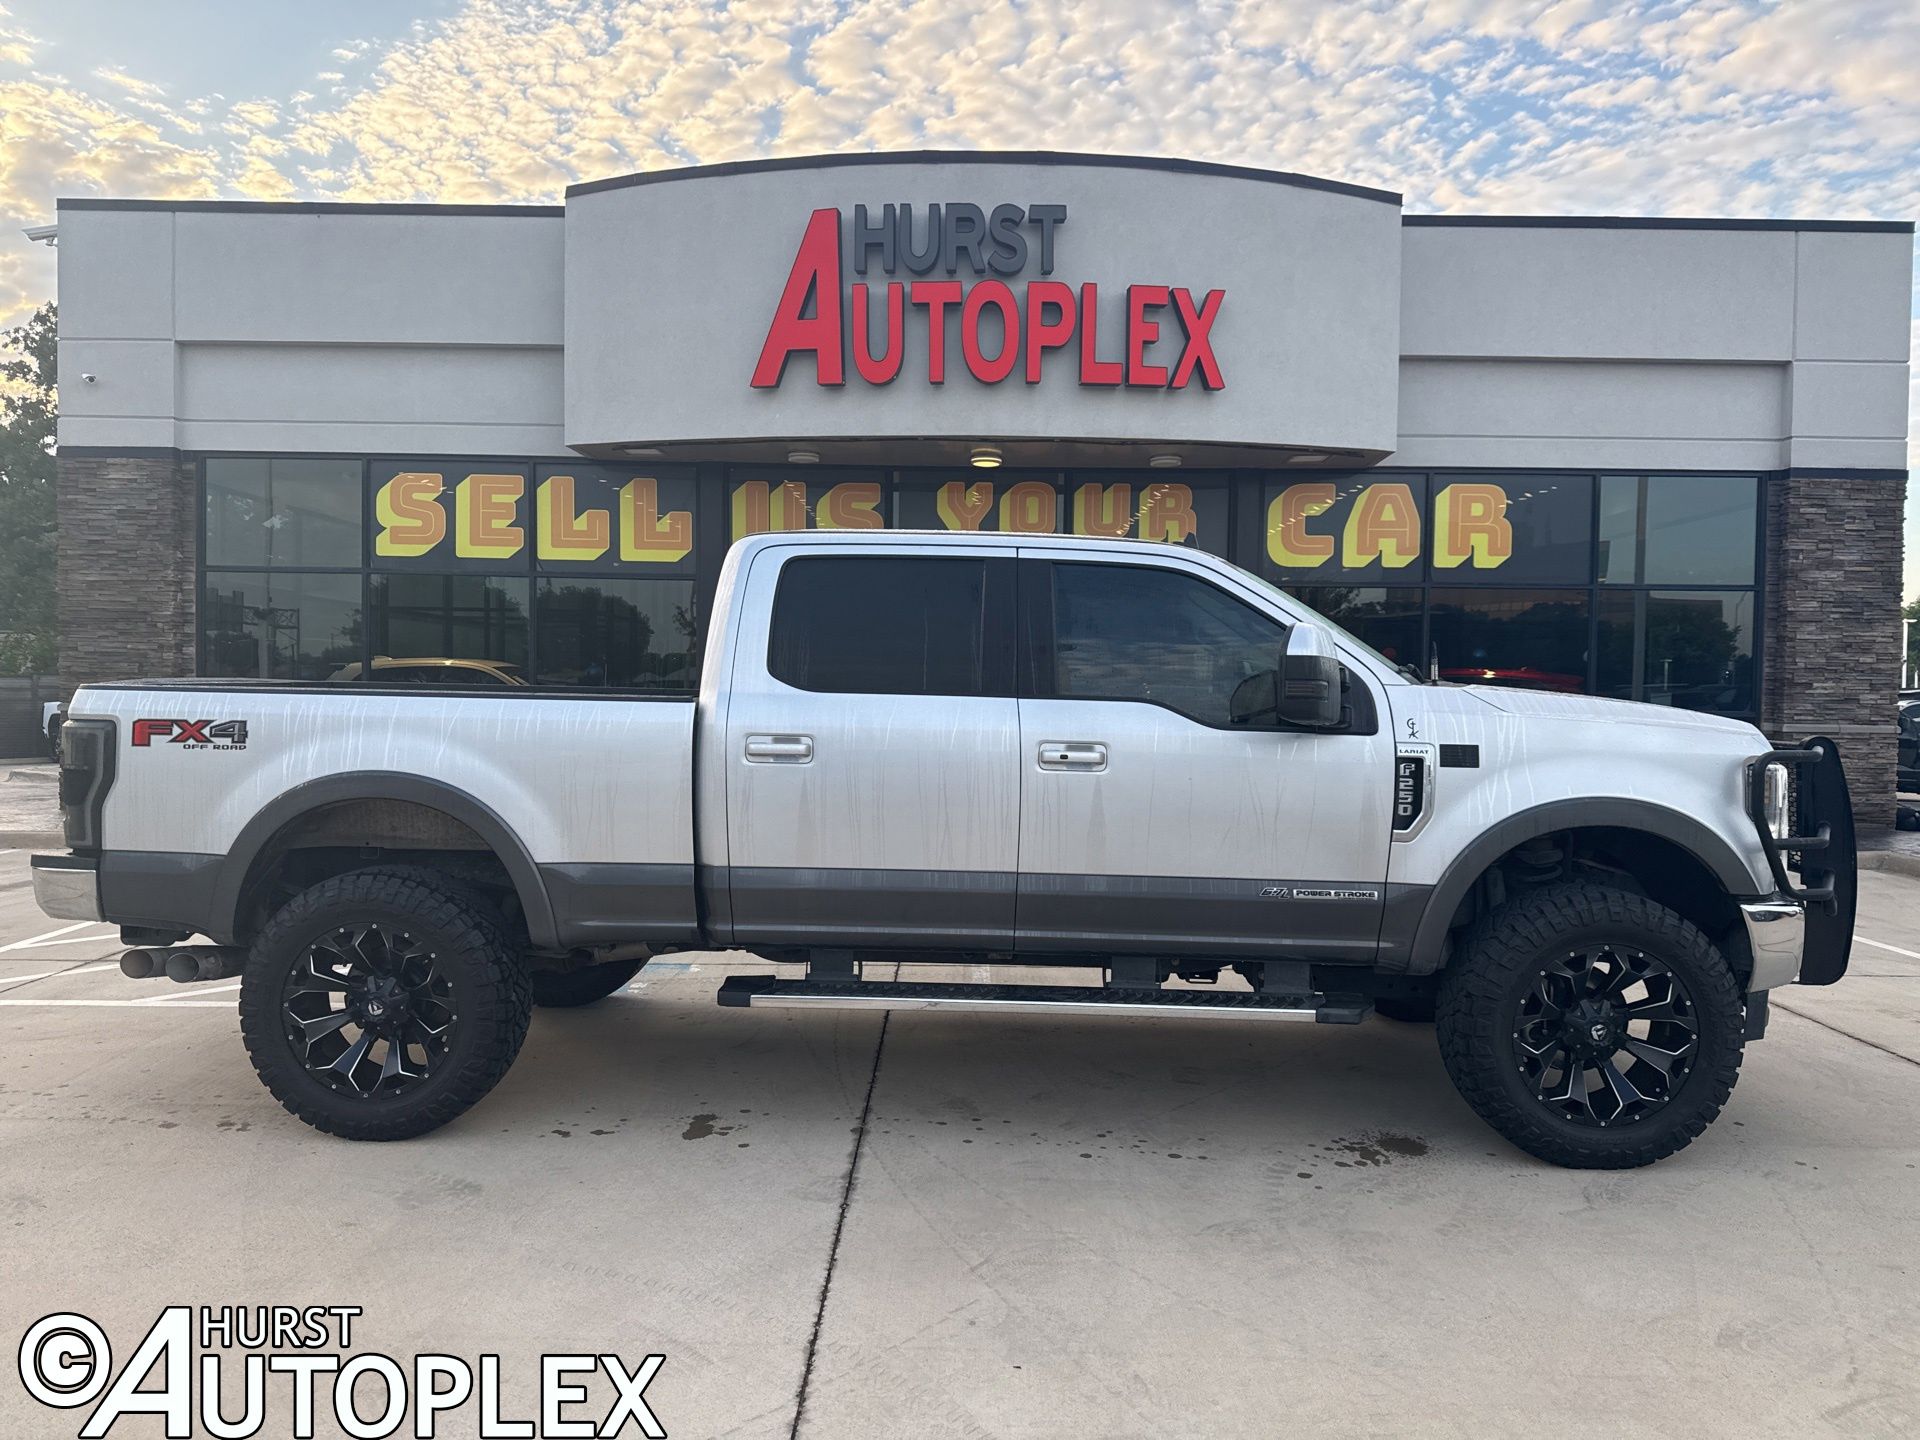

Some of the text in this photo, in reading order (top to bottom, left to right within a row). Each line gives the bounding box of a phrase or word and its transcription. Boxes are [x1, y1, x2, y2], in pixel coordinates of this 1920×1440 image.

[854, 203, 1067, 275] HURST
[750, 207, 1226, 391] AUTOPLEX
[375, 472, 693, 563] SELL
[936, 481, 1197, 544] YOUR
[1267, 483, 1513, 569] CAR
[131, 719, 248, 747] FX4
[1296, 890, 1332, 898] POWER
[1334, 891, 1375, 899] STROKE
